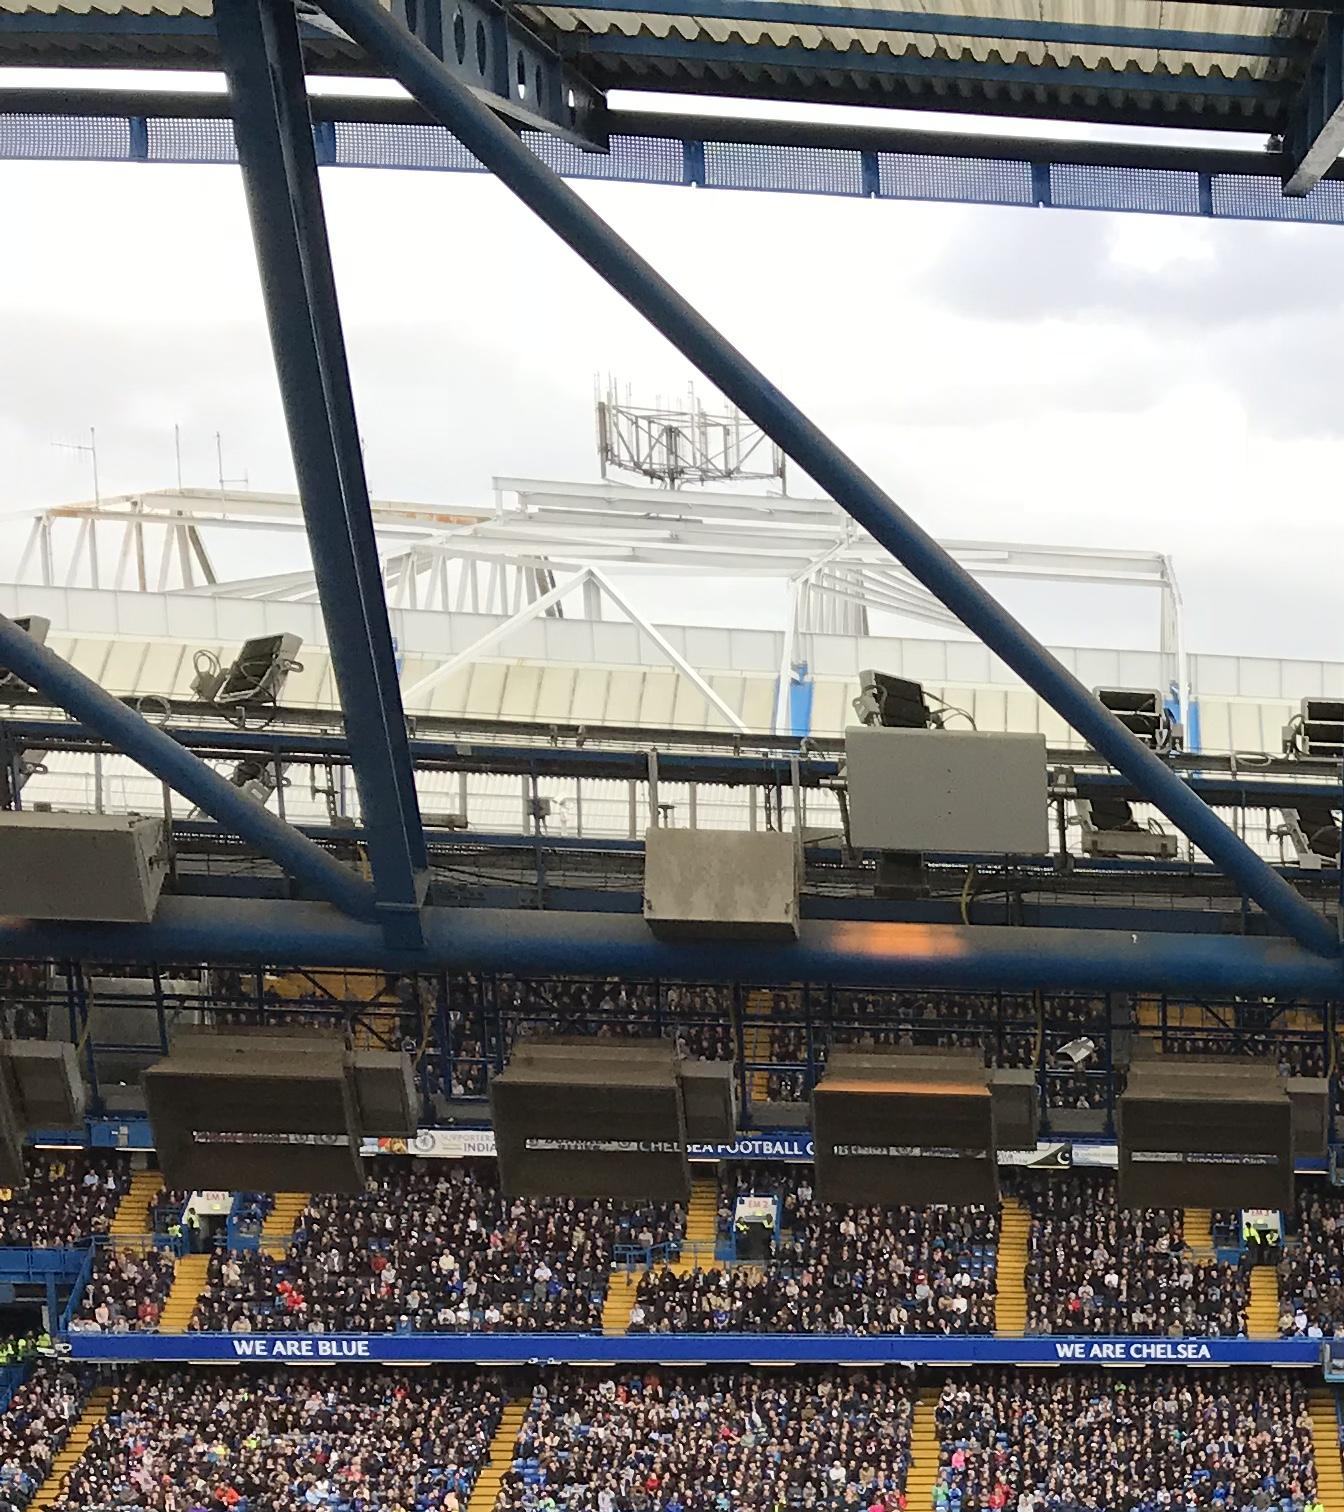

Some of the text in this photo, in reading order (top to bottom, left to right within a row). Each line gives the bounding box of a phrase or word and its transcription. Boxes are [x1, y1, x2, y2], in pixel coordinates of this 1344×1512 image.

[717, 1141, 804, 1155] FOOTBALL
[233, 1340, 370, 1355] WE ARE BLUE
[1055, 1343, 1211, 1359] WE ARE CHELSEA
